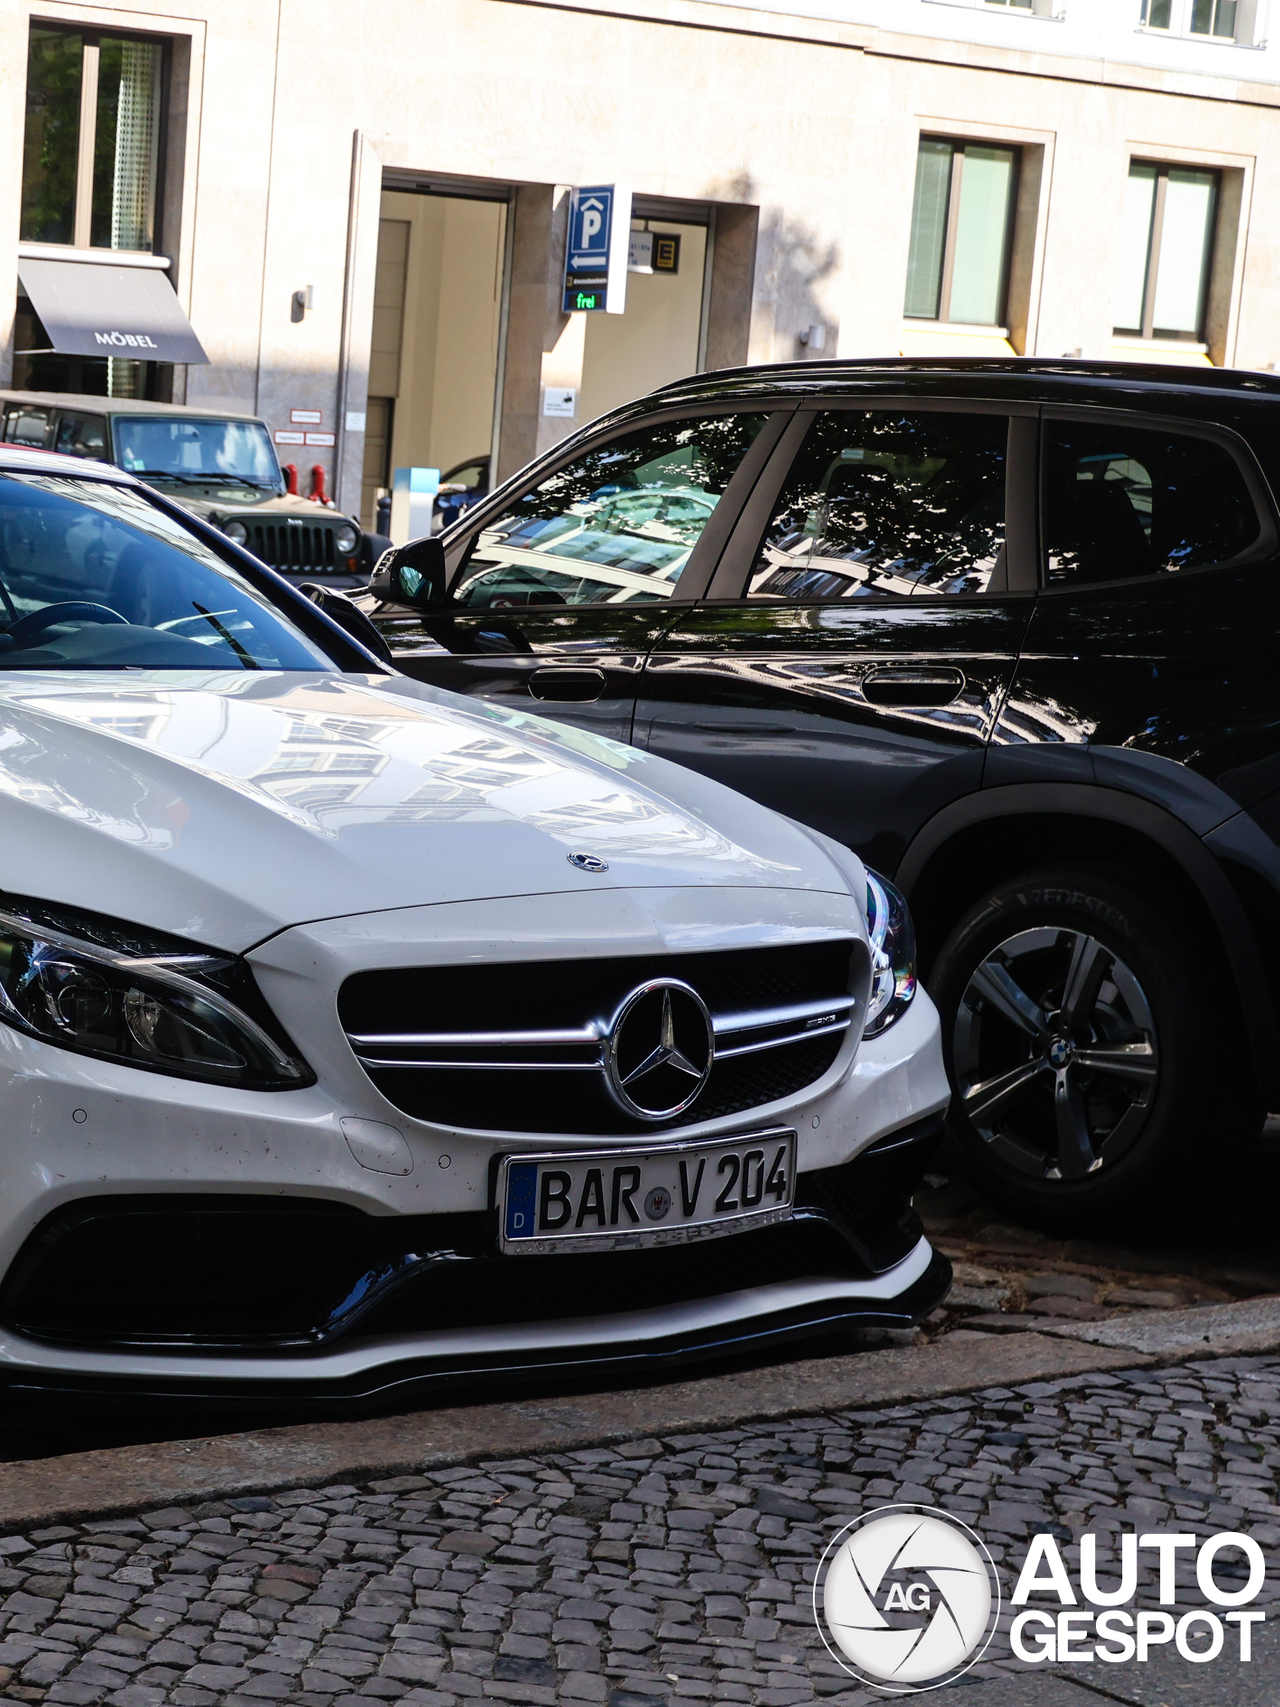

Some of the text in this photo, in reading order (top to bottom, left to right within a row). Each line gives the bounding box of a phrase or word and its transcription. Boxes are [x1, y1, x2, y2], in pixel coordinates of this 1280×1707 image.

[581, 209, 602, 249] P
[576, 292, 595, 309] frei
[94, 330, 158, 349] MÖBEL
[513, 1145, 788, 1230] D BAR V 204
